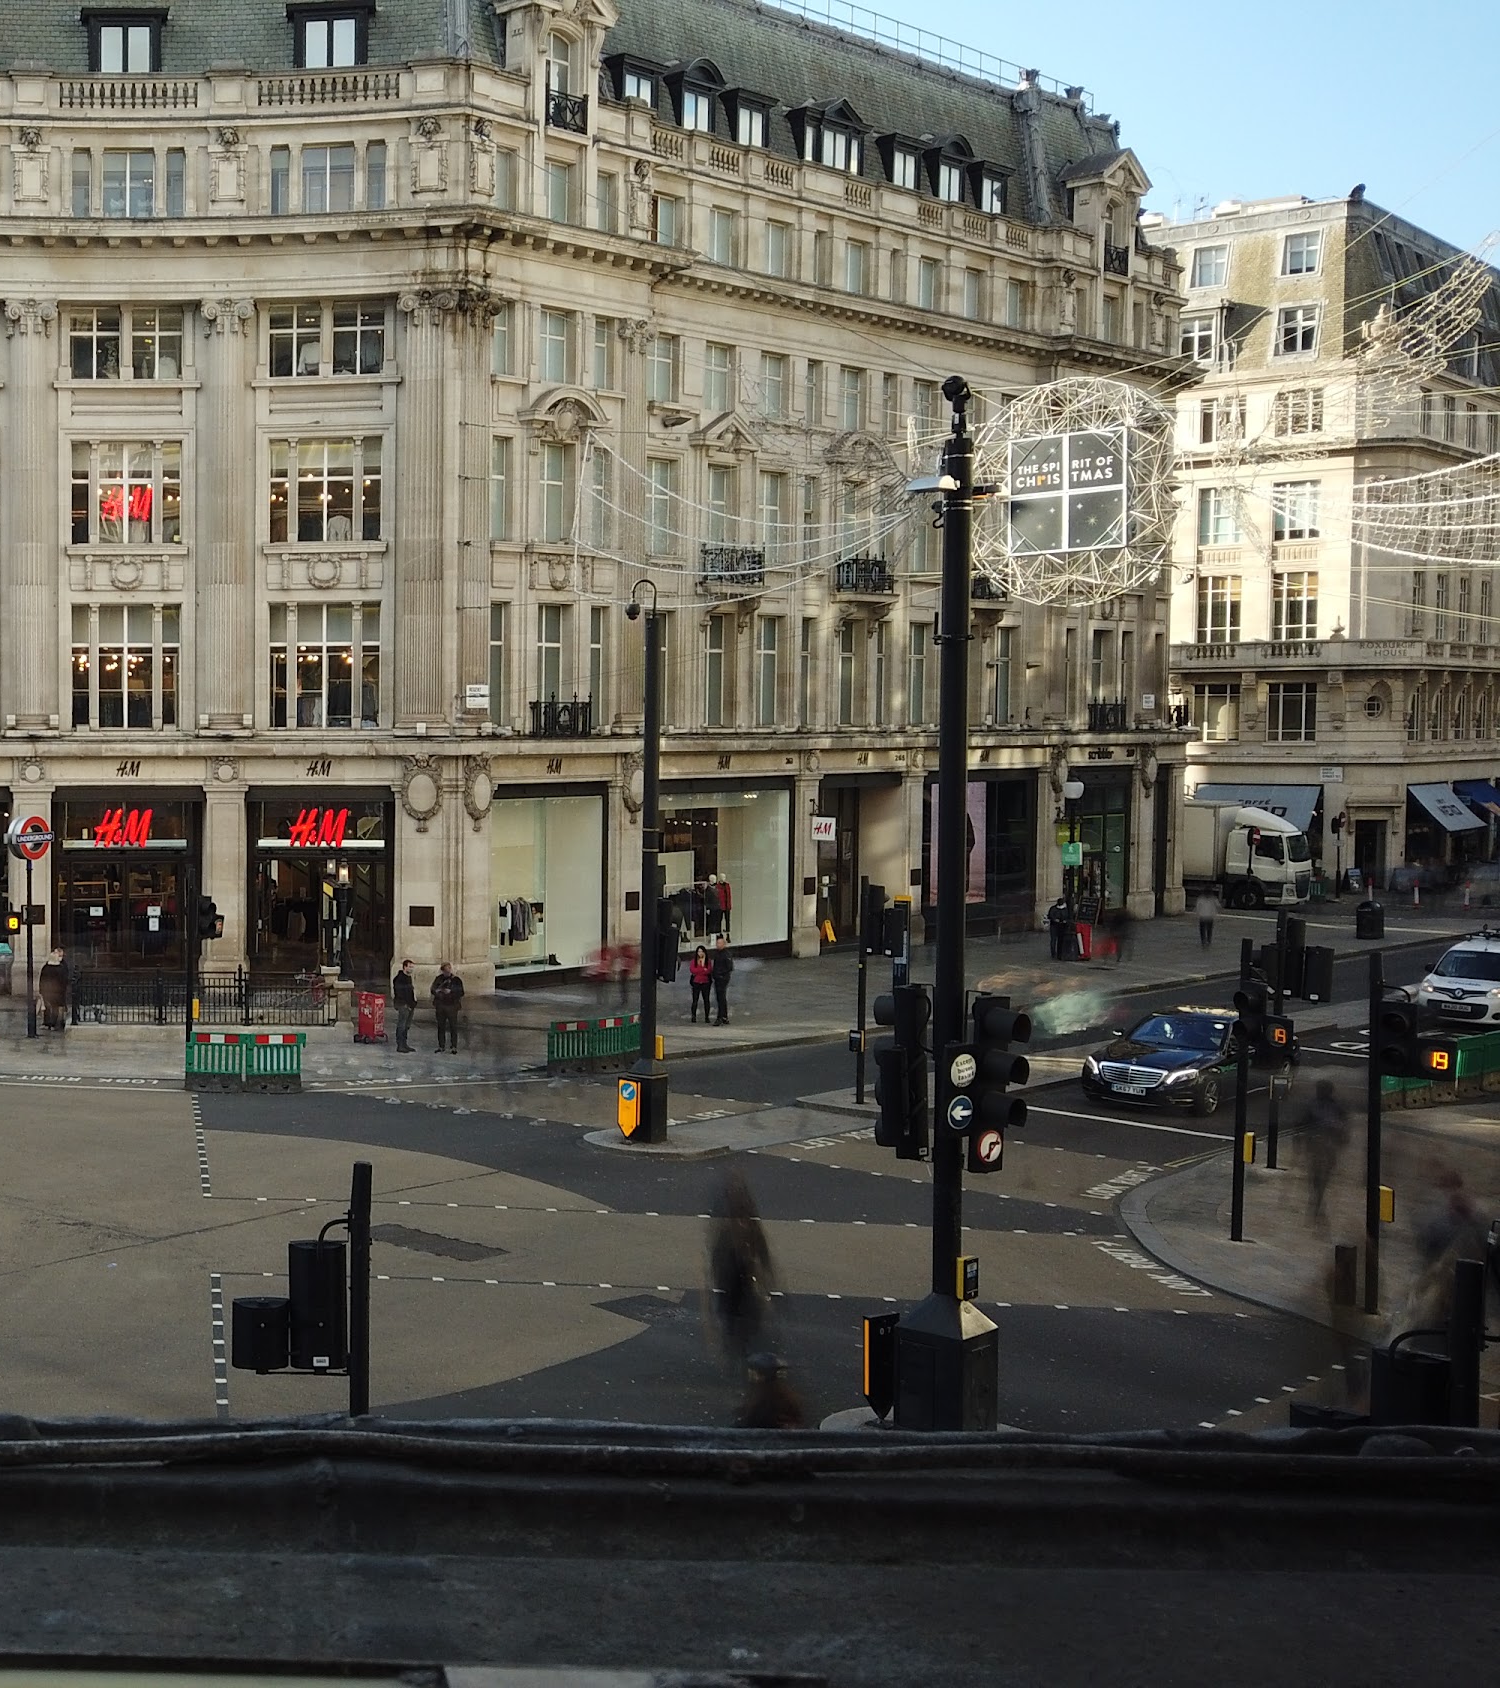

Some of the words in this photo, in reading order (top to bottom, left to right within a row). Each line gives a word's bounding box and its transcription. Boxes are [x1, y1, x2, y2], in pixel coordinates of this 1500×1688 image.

[1018, 464, 1039, 475] THE
[1096, 456, 1113, 466] OF
[116, 760, 141, 777] H&M
[306, 760, 331, 777] H&M
[546, 758, 562, 774] H&M
[717, 754, 731, 770] H&M
[94, 808, 153, 847] H&M
[289, 807, 348, 847] H&M
[813, 822, 833, 836] H&M
[17, 833, 53, 843] UNDERGROUND
[1432, 1052, 1449, 1070] 19
[1146, 1273, 1213, 1296] LOOK
